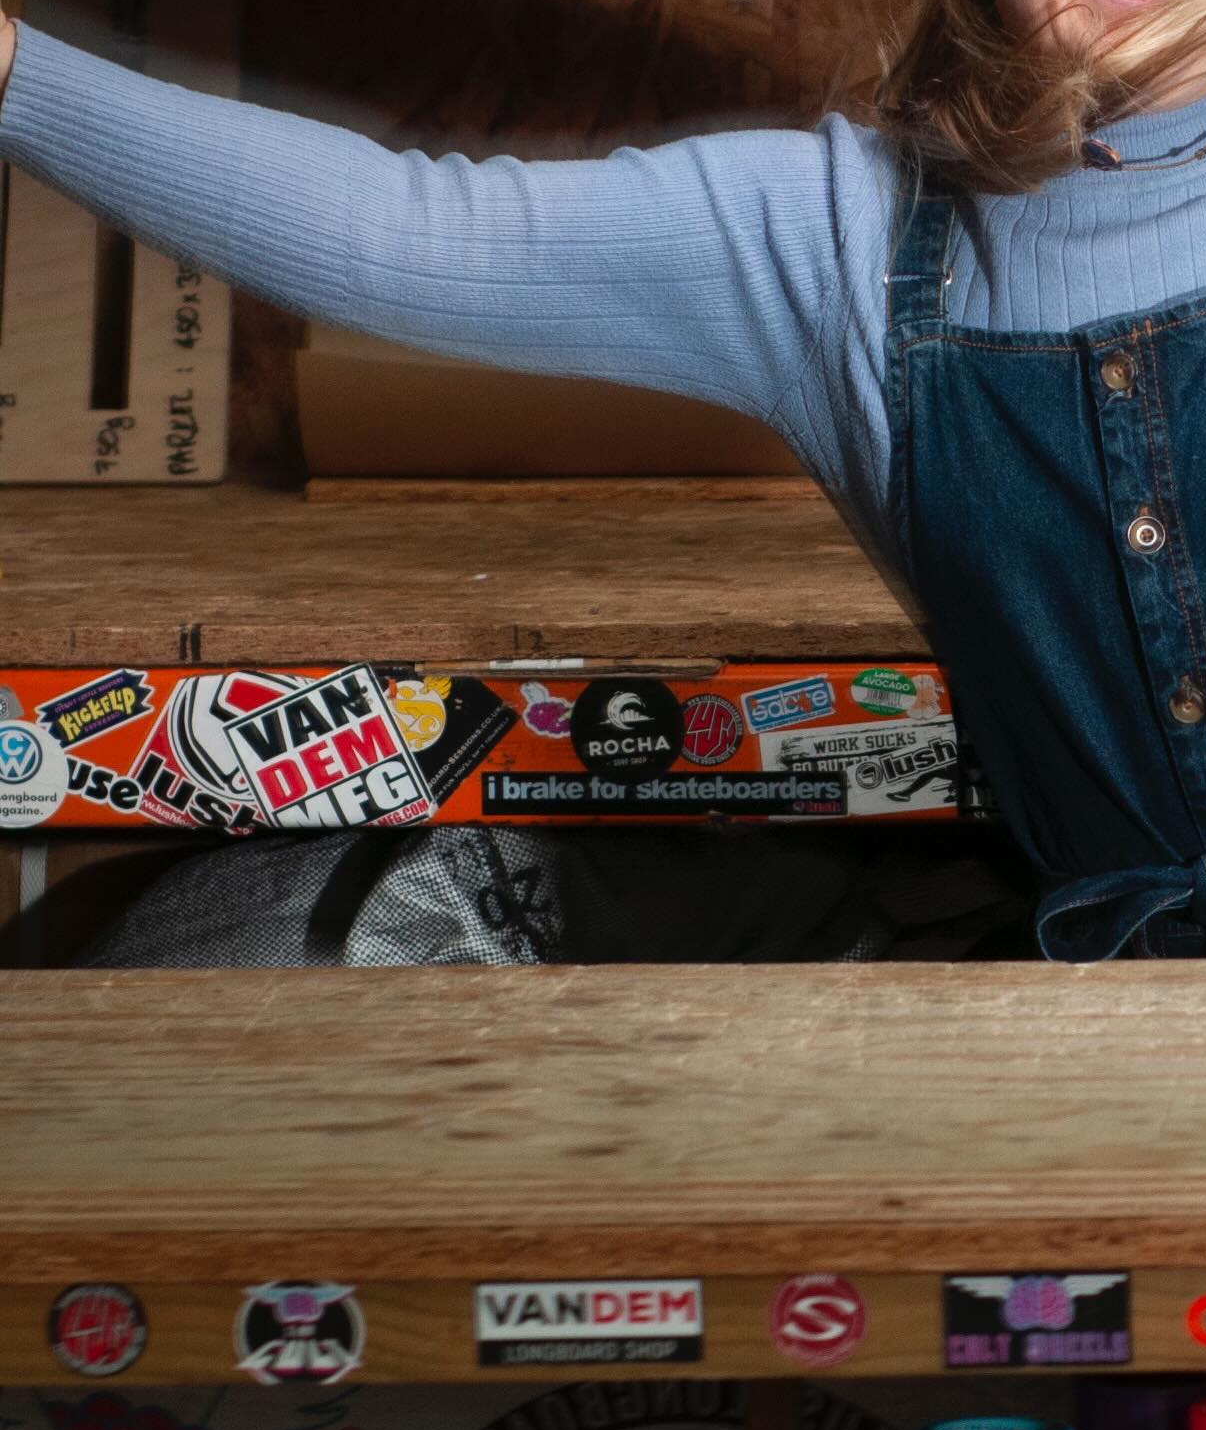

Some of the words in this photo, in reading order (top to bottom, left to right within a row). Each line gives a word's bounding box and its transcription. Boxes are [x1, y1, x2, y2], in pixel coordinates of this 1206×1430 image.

[861, 676, 910, 691] AVOCADO
[874, 671, 901, 682] LARGE
[238, 675, 374, 762] VAN
[589, 735, 671, 756] ROCHA
[813, 735, 861, 755] WORK
[865, 731, 917, 749] SUCKS
[256, 715, 398, 809] DEM
[881, 737, 958, 782] lush
[0, 792, 57, 804] ongboard
[487, 775, 495, 800] i
[502, 776, 584, 800] brake
[591, 777, 626, 800] for
[636, 776, 842, 800] skateboarders
[484, 1291, 696, 1327] VANDEM
[504, 1341, 618, 1363] LONGBOARD
[624, 1340, 678, 1361] SHOP
